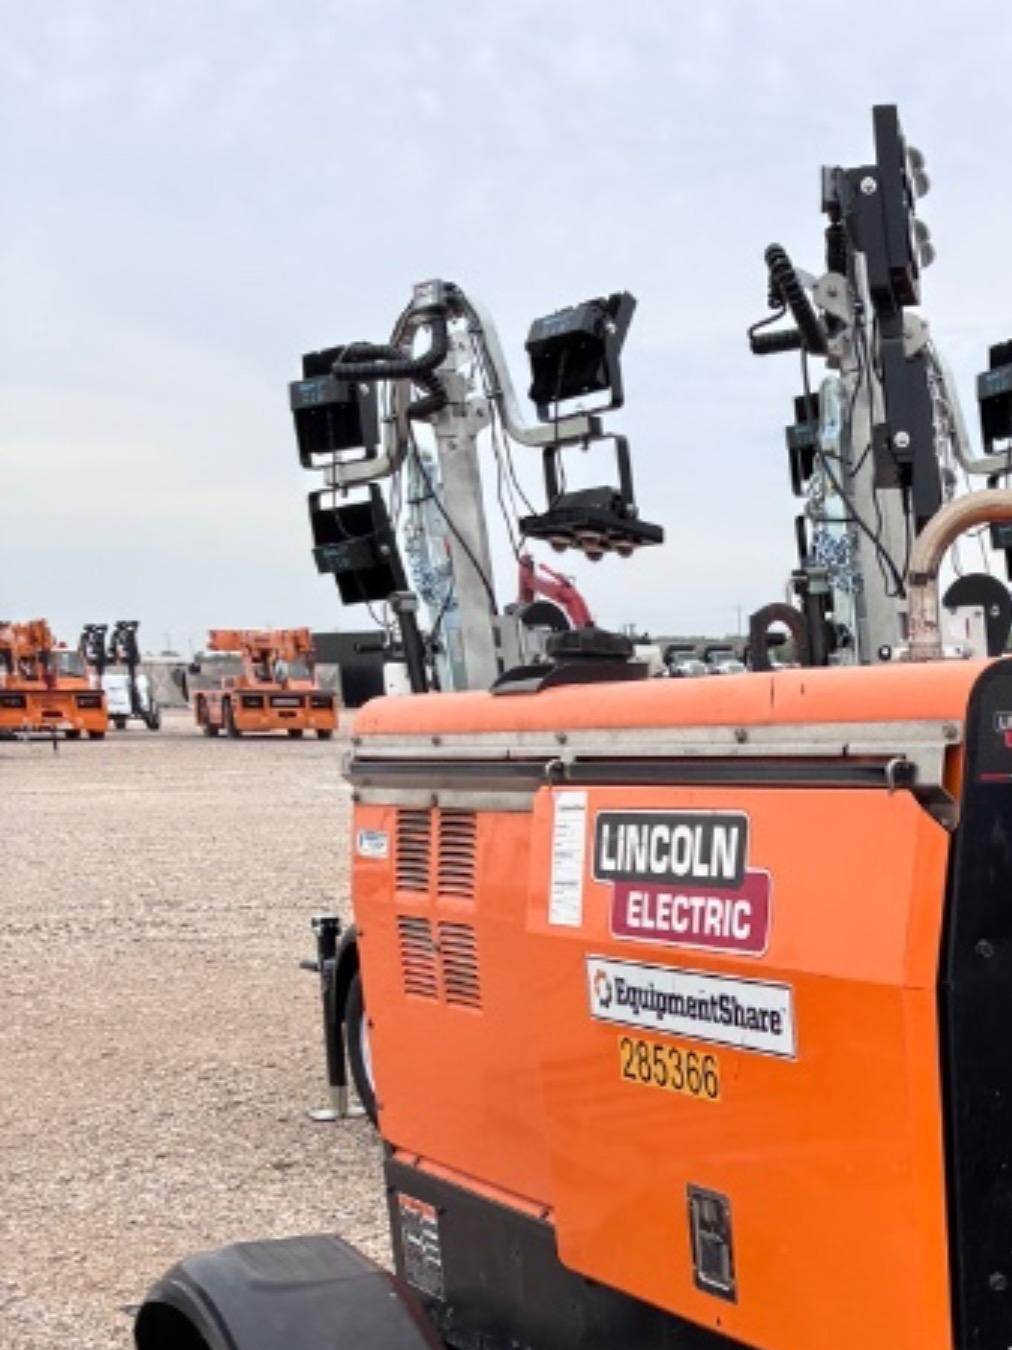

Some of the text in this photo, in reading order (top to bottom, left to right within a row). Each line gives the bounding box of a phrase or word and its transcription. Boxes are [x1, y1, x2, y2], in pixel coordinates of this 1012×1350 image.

[600, 824, 739, 878] LINCOLN
[626, 893, 752, 940] ELECTRIC
[614, 977, 784, 1036] EquipmentShare
[619, 1037, 720, 1099] 285366
